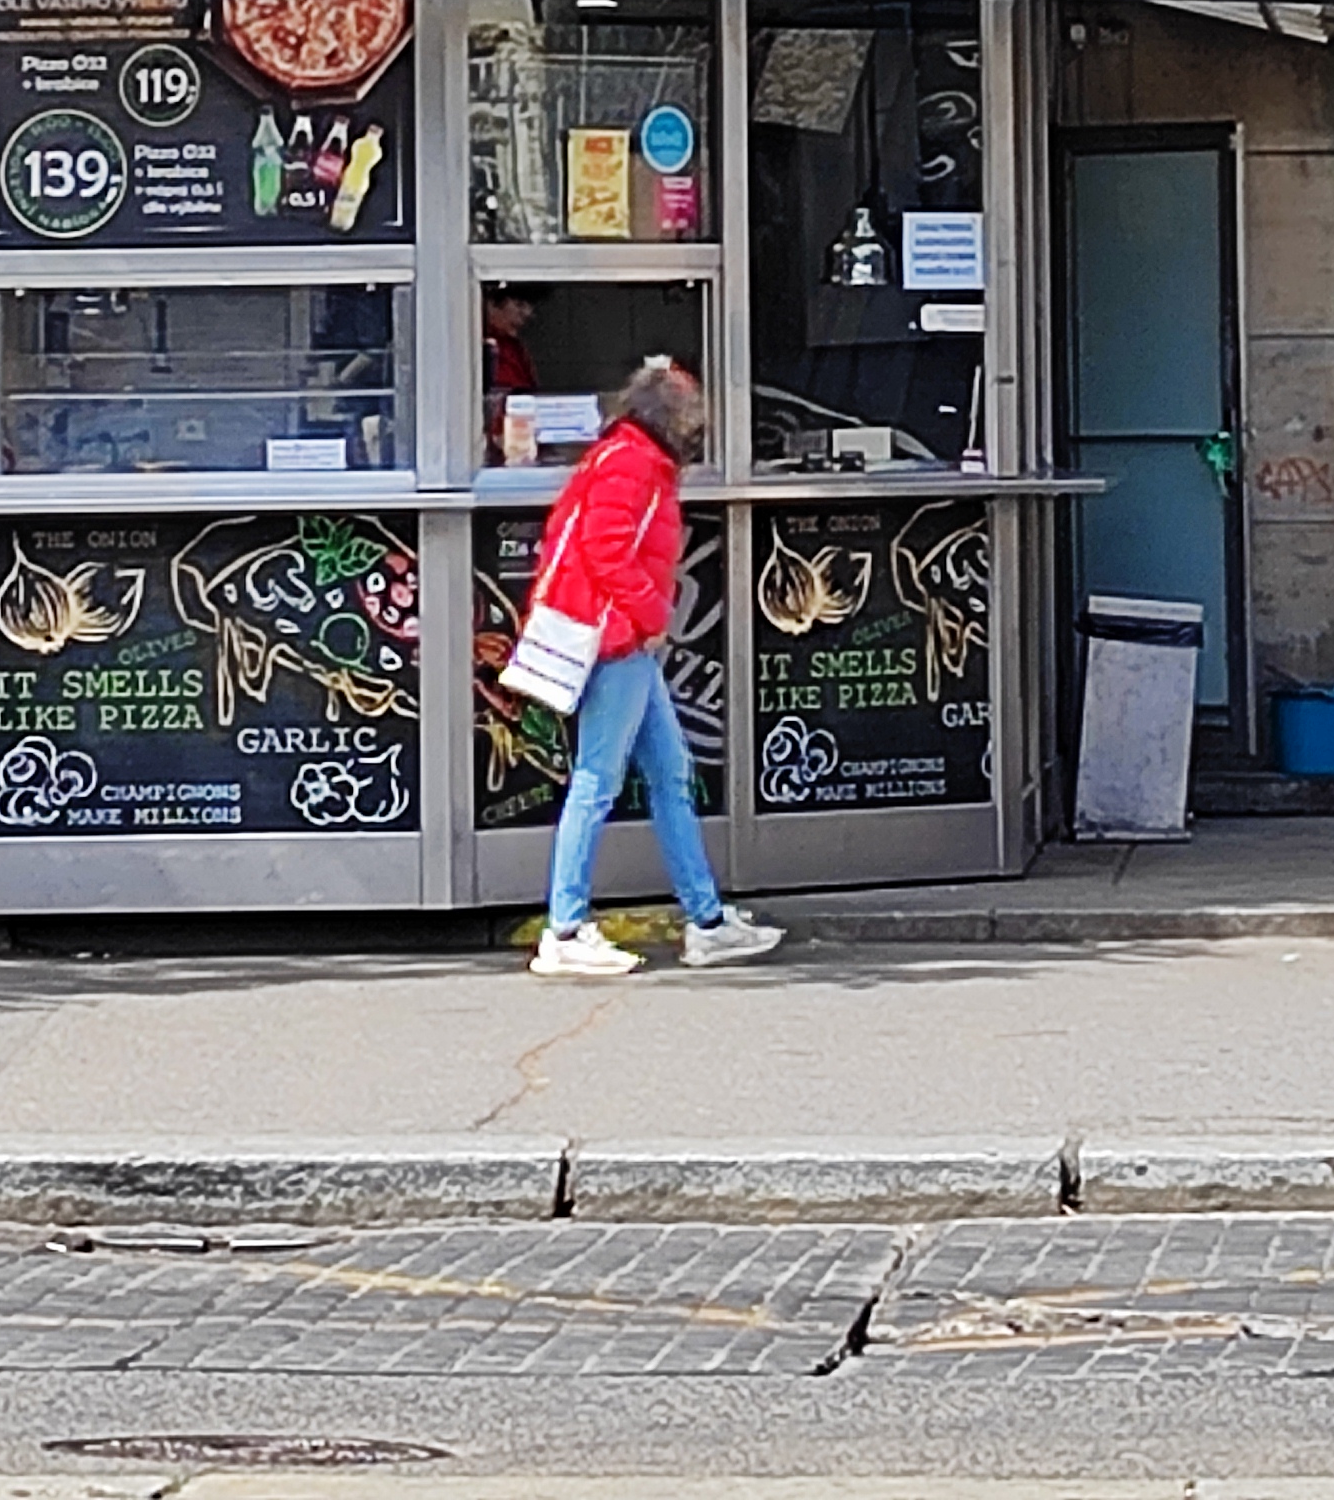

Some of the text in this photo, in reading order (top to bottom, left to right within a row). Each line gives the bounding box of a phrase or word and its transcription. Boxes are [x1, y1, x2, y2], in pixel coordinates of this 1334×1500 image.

[31, 530, 158, 550] THE ONION
[118, 630, 197, 667] OLIVES
[758, 648, 917, 682] IT SMELLS
[61, 669, 205, 699] SMELLS
[758, 681, 918, 713] LIKE PIZZA
[97, 704, 205, 730] PIZZA
[236, 726, 378, 754] GARLIC
[100, 784, 242, 802] CHAMPIGNONS
[66, 805, 243, 826] MAKE MILLIONS
